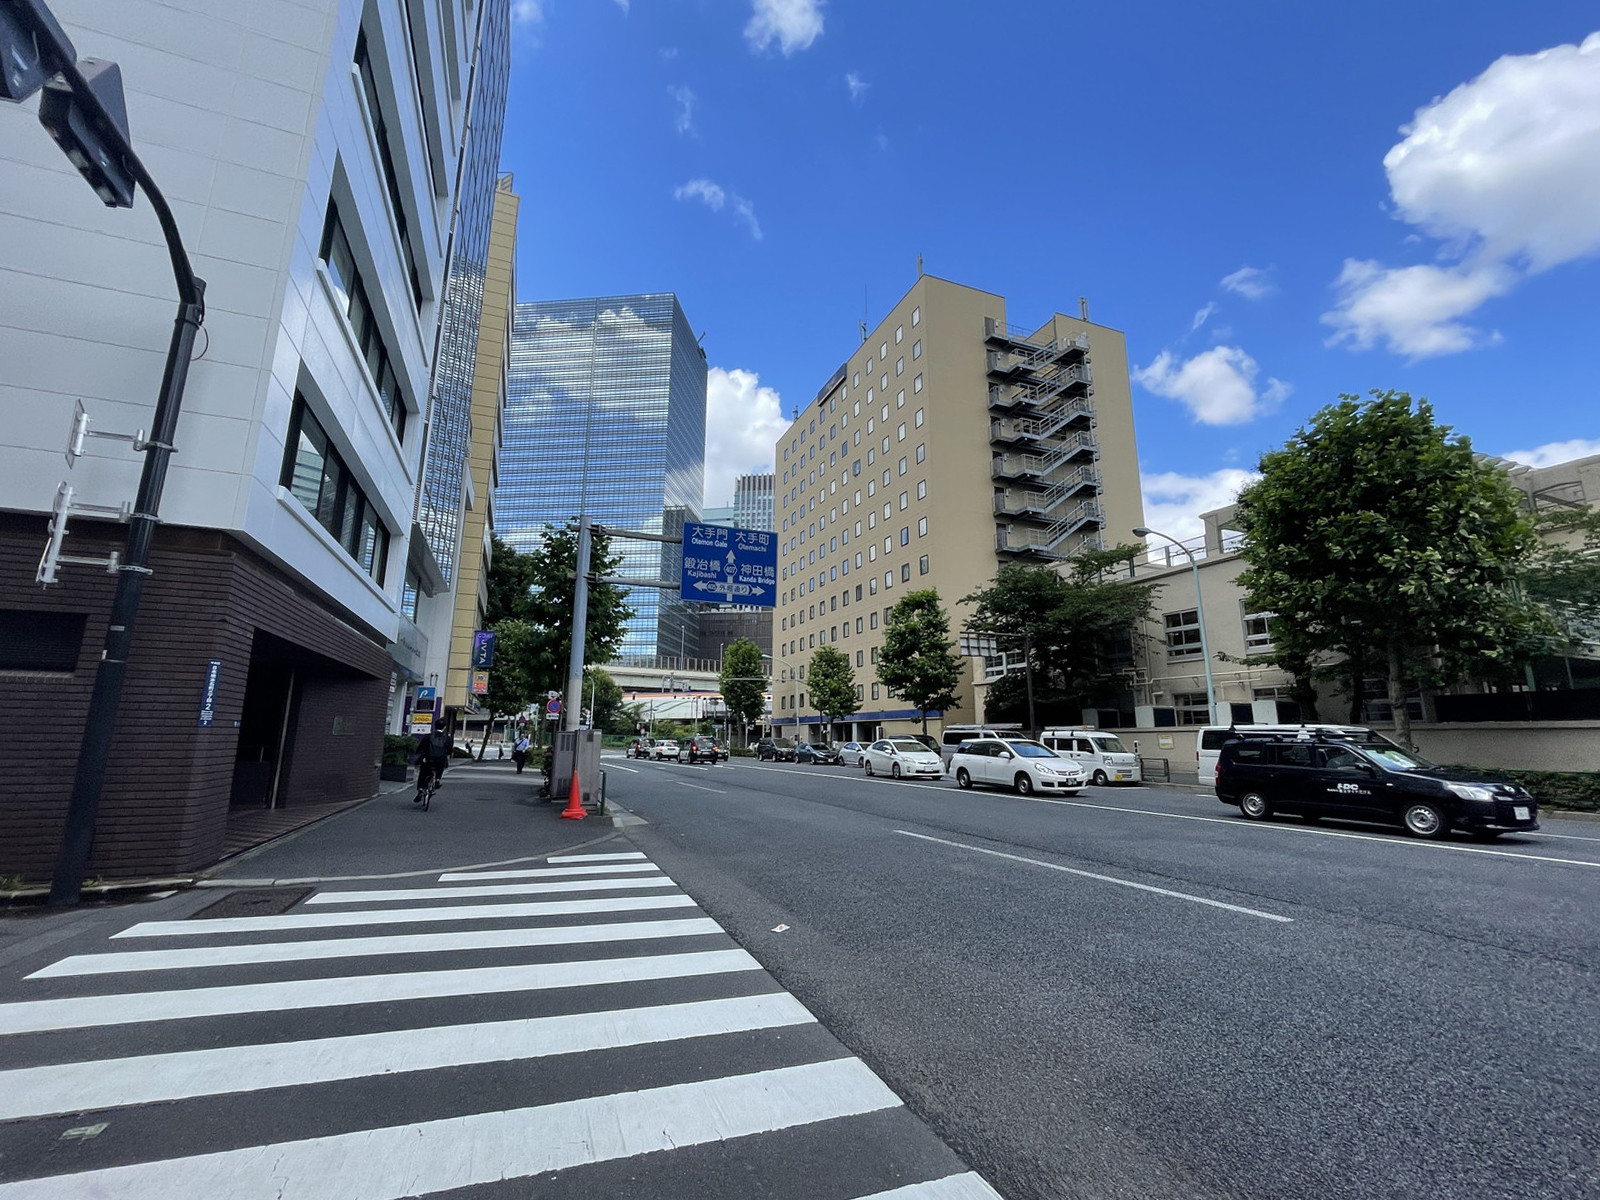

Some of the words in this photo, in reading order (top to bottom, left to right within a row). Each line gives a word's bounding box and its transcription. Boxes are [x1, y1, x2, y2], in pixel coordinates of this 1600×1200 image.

[692, 526, 728, 540] 大手門
[735, 532, 770, 546] 大手町
[738, 543, 767, 552] Otemachi
[684, 557, 720, 572] 鍛冶橋
[688, 570, 717, 578] Kajibashi
[741, 564, 774, 577] 神田橋
[758, 577, 776, 585] Bridge
[720, 584, 748, 593] 外堀通り
